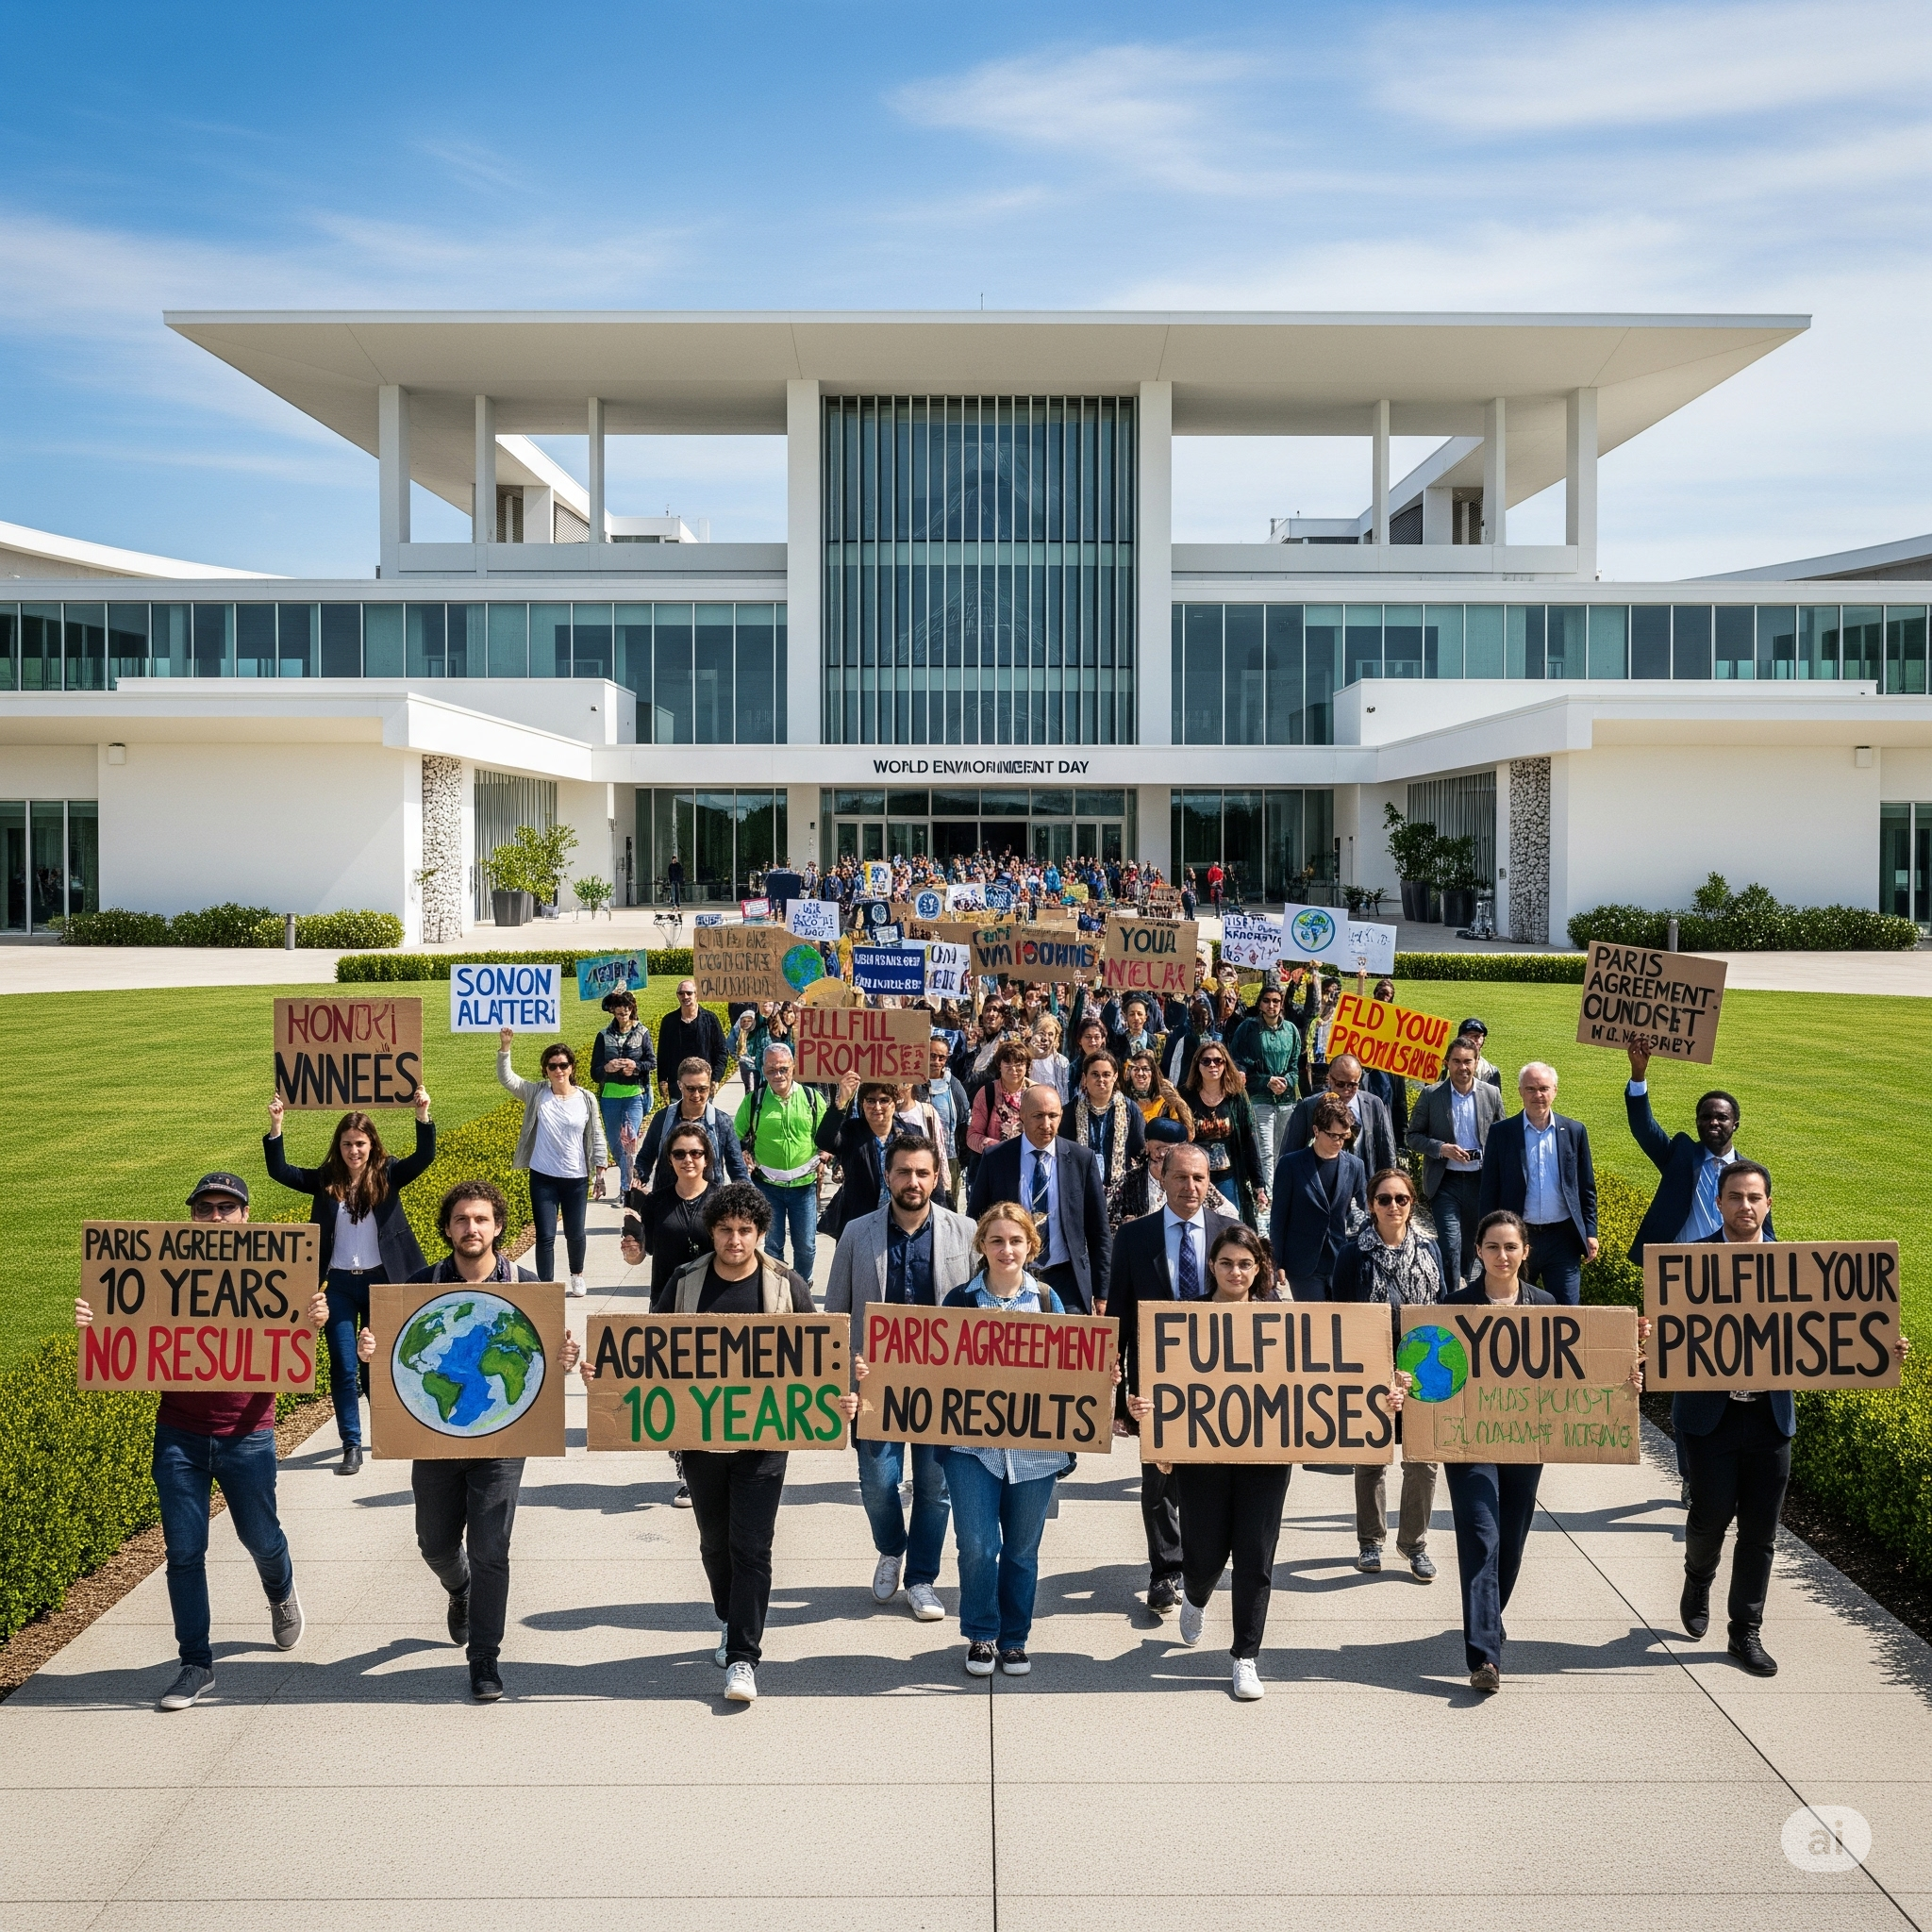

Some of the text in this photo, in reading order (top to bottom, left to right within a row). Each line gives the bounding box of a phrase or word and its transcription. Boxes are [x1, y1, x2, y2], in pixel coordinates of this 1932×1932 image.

[1058, 760, 1090, 774] DAY
[457, 967, 552, 997] SONON
[1594, 945, 1663, 977] PARIS
[1336, 994, 1385, 1031] FLD
[85, 1228, 313, 1263] PARIS AGREEMENT:
[99, 1267, 299, 1324] 10 YEARS,
[1658, 1251, 1898, 1306] FULFILL YOUR
[85, 1325, 312, 1384] NO RESULTS
[593, 1324, 841, 1379] AGREEMENT:
[869, 1315, 949, 1366] PARIS
[1154, 1312, 1364, 1374] FULFILL
[1455, 1314, 1586, 1380] YOUR
[1657, 1310, 1890, 1379] PROMISES
[623, 1383, 842, 1442] 10 YEARS
[882, 1385, 932, 1434] NO
[1153, 1383, 1393, 1449] PROMISES
